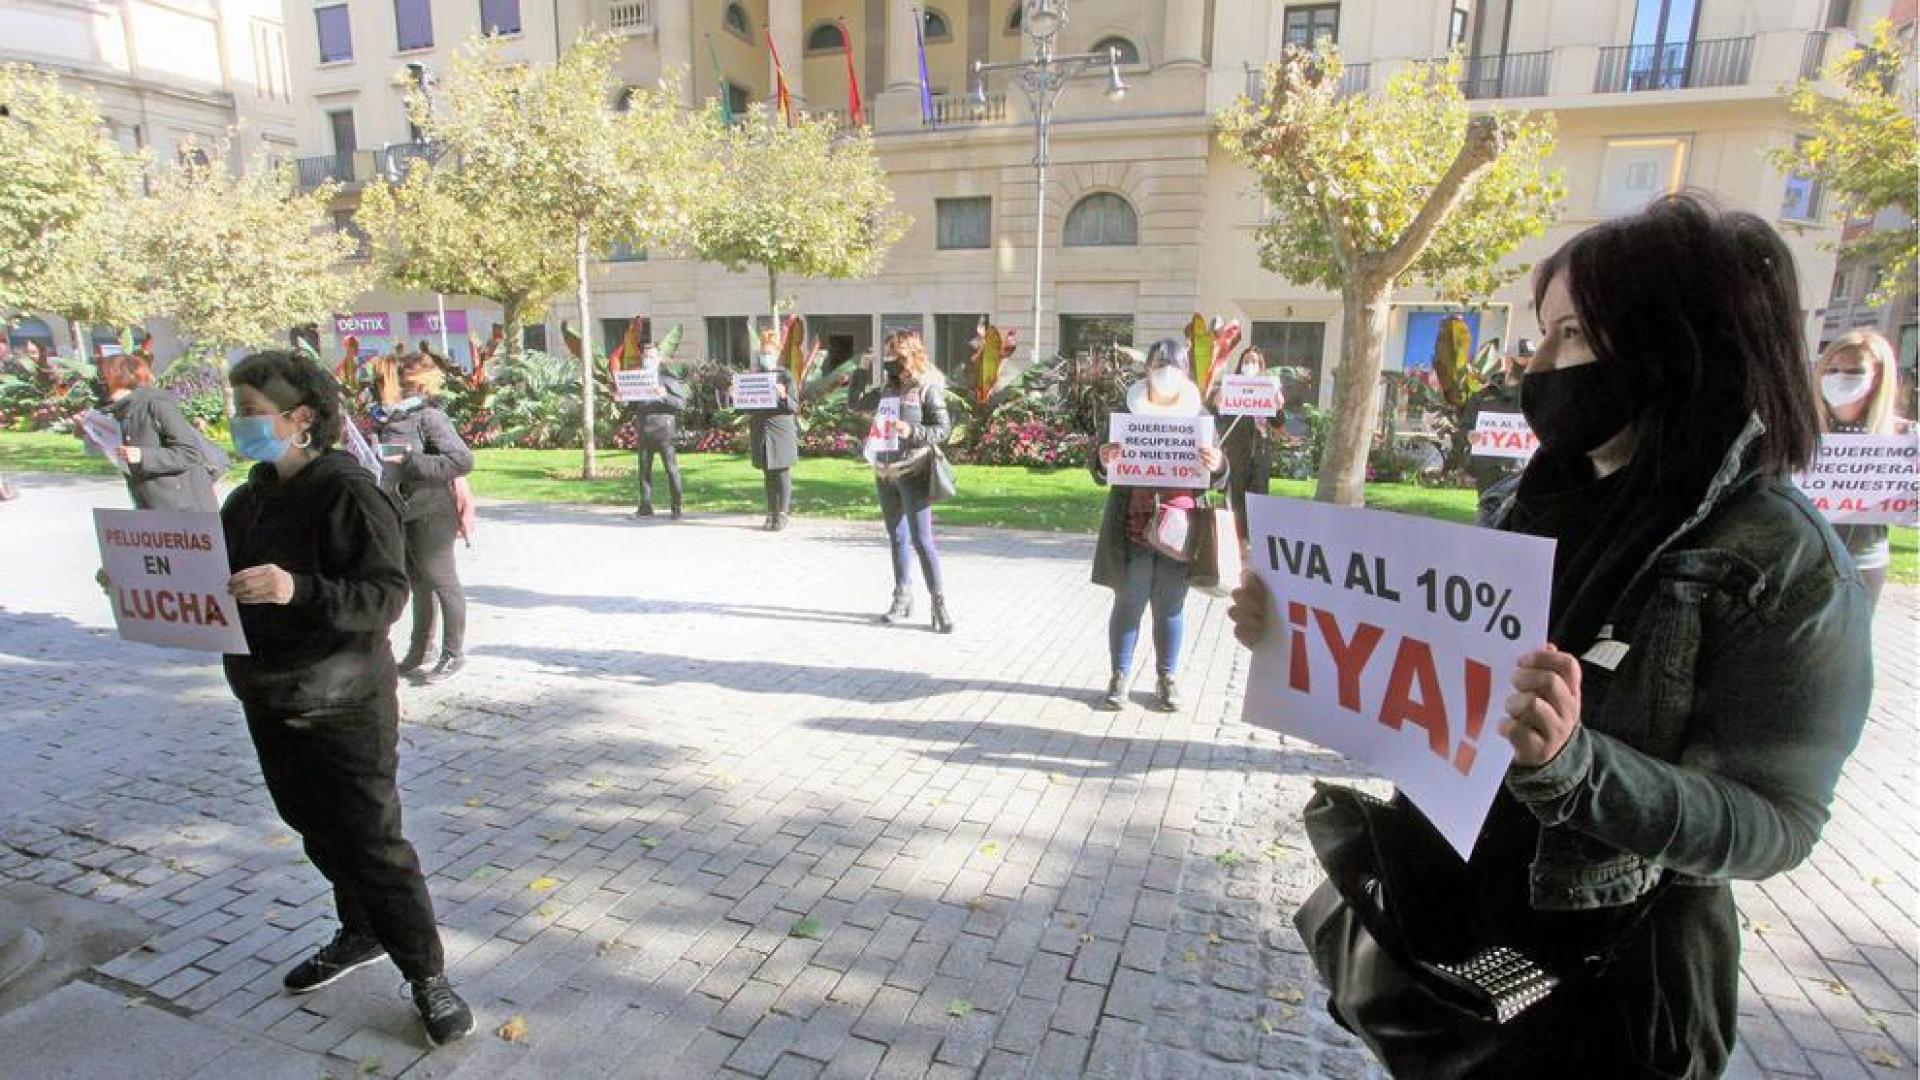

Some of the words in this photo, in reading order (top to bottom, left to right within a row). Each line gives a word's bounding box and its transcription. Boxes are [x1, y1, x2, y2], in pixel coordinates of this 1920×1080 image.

[336, 317, 386, 331] DENTIX
[1225, 397, 1273, 408] LUCHA
[1128, 423, 1195, 434] QUEREMOS
[1125, 435, 1196, 447] RECUPERAR
[1122, 449, 1137, 458] LO
[1139, 451, 1196, 461] NUESTRO
[1116, 464, 1141, 476] IVA
[1145, 465, 1165, 476] AL
[1172, 466, 1202, 478] 10%
[1814, 463, 1919, 473] RECUPERA
[1802, 480, 1826, 489] LO
[1838, 498, 1869, 512] AL
[105, 528, 212, 551] PELUQUERÍAS
[143, 555, 171, 575] EN
[1267, 534, 1333, 585] IVA
[1344, 552, 1401, 603] AL
[1416, 567, 1522, 641] 10%
[118, 586, 229, 627] LUCHA
[1288, 600, 1493, 777] ¡YA!
